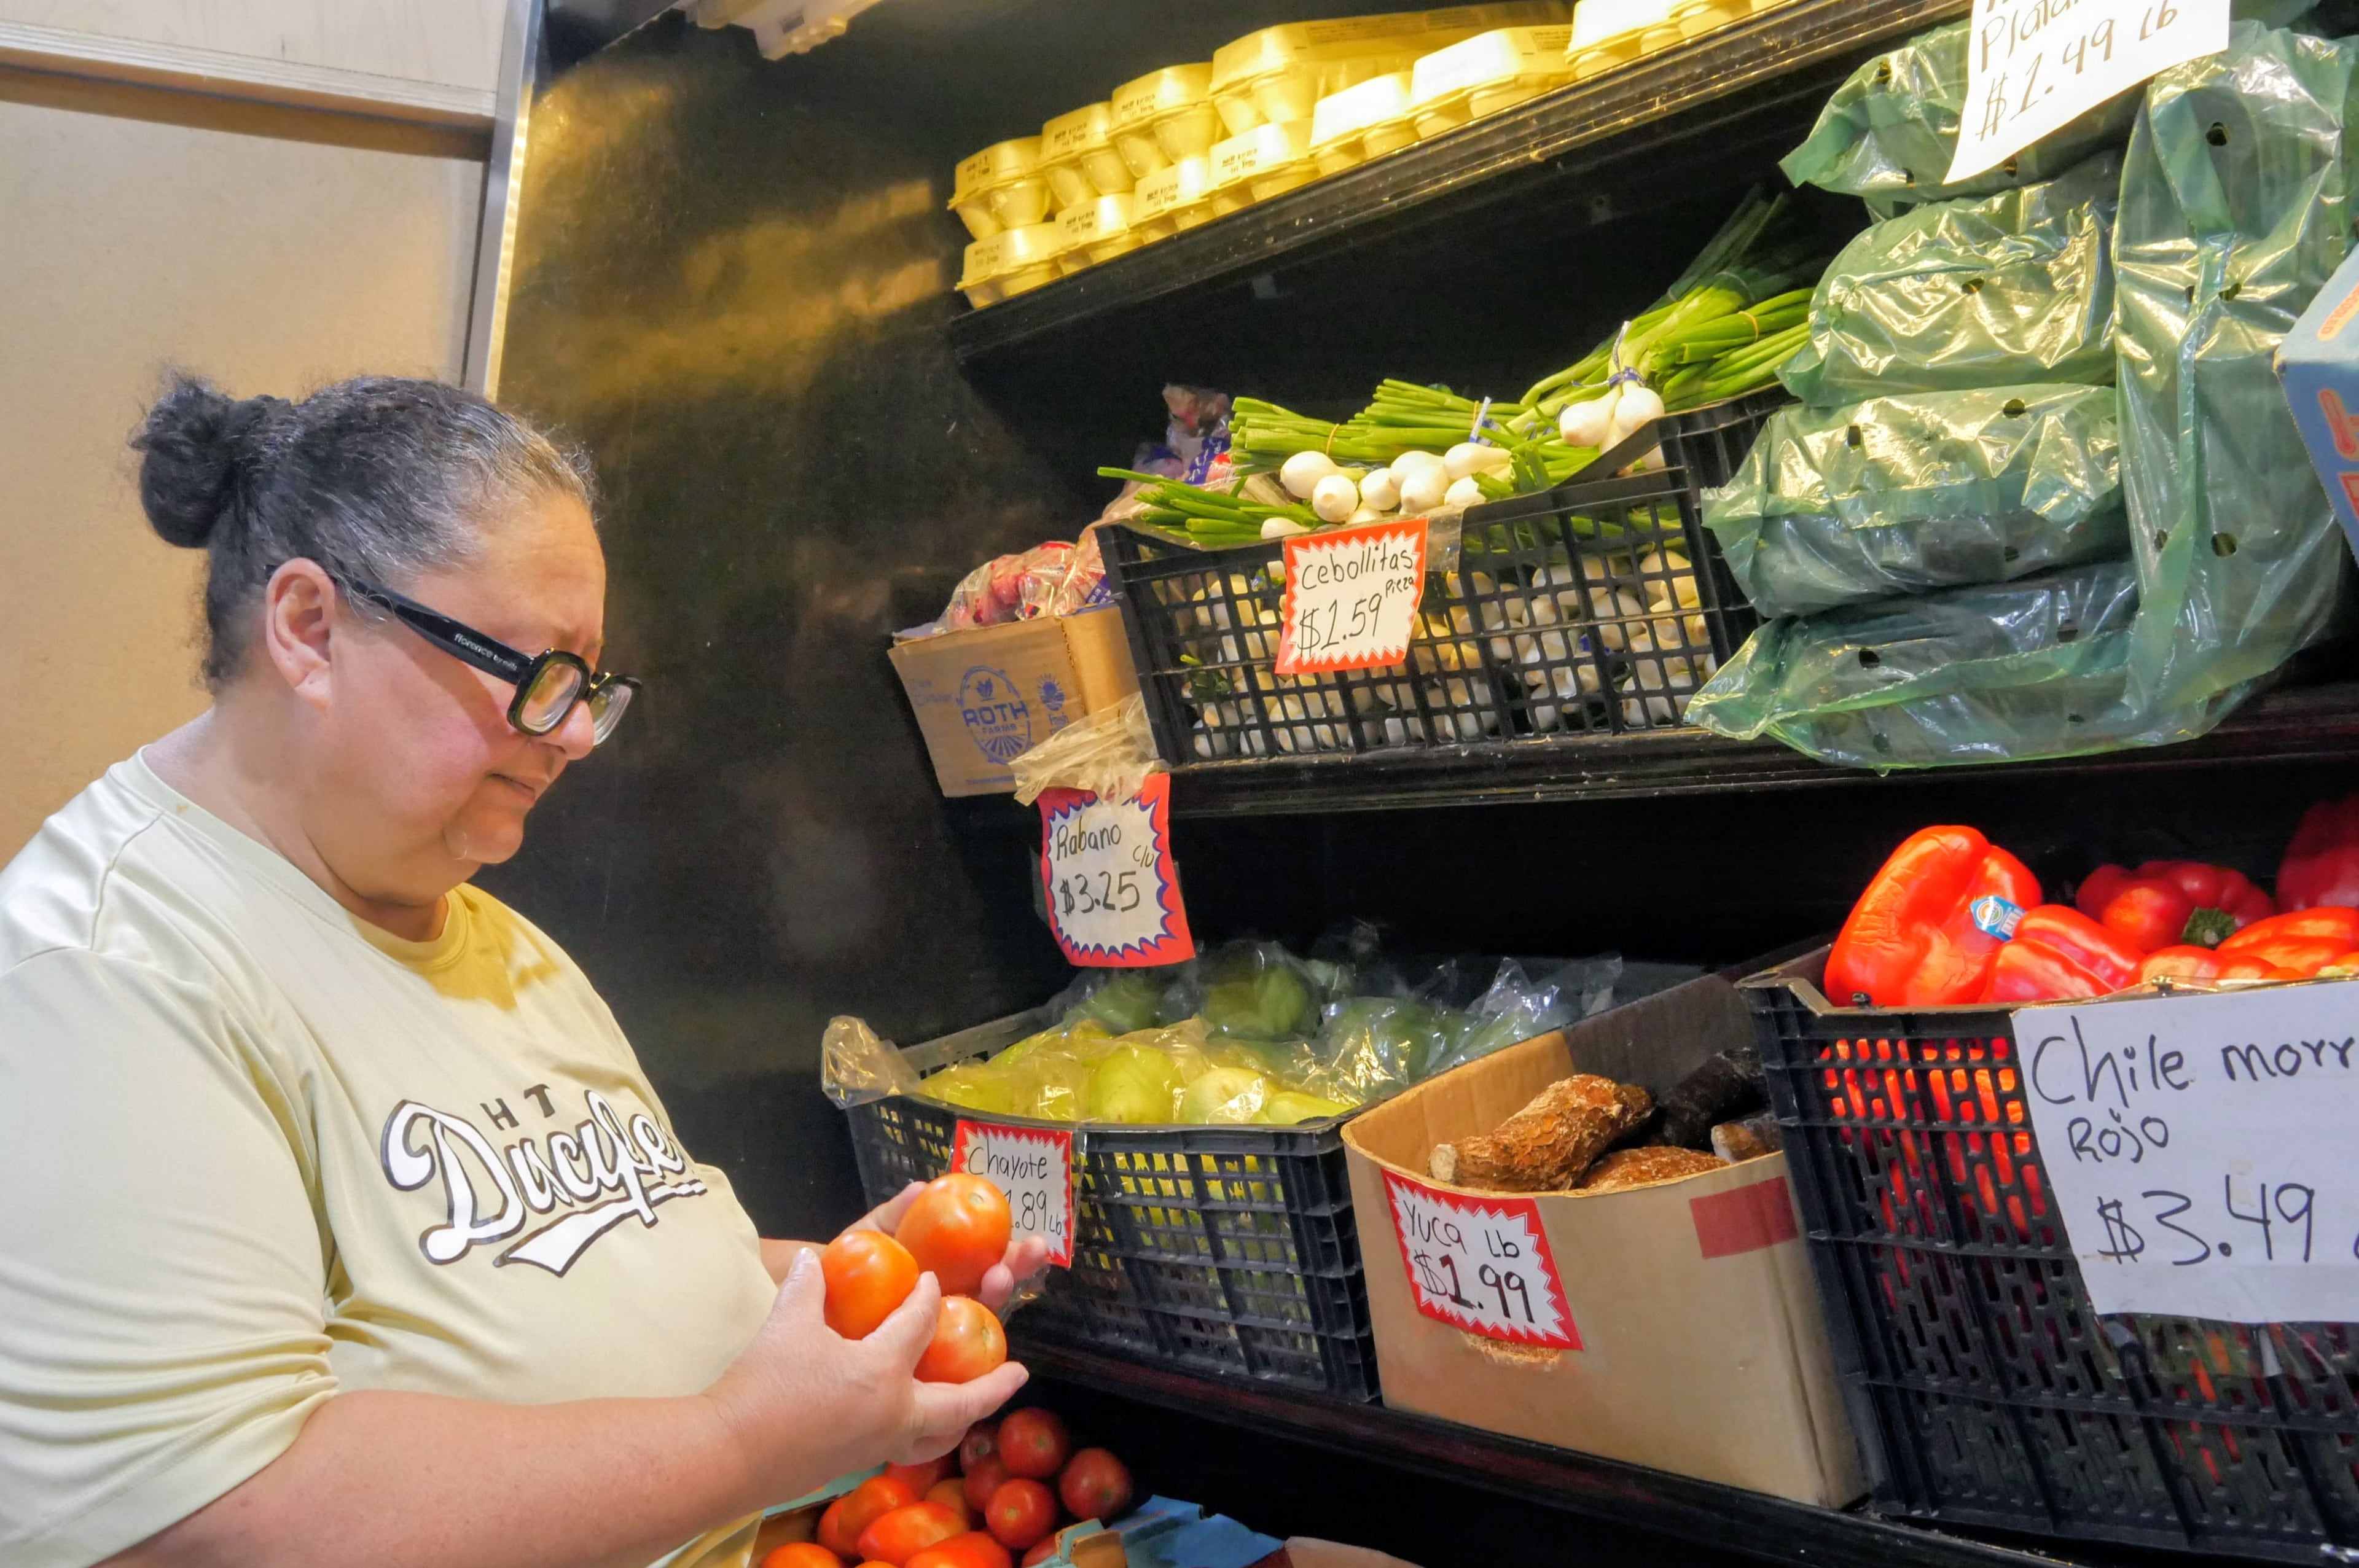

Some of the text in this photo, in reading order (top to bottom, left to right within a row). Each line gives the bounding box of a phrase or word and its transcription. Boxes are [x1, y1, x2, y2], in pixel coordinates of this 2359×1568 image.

[1981, 0, 2078, 73] Plata
[1297, 593, 1382, 658] $1.59
[962, 700, 1030, 727] ROTH
[982, 724, 1017, 735] FARMS
[1056, 815, 1122, 861] Rabano
[1060, 871, 1140, 916] $3.25
[2032, 1015, 2190, 1108] Chile
[968, 1139, 1047, 1180] Chayote
[2067, 1107, 2169, 1163] Rojo
[2097, 1174, 2315, 1266] $3.49
[1414, 1249, 1535, 1324] $1.99
